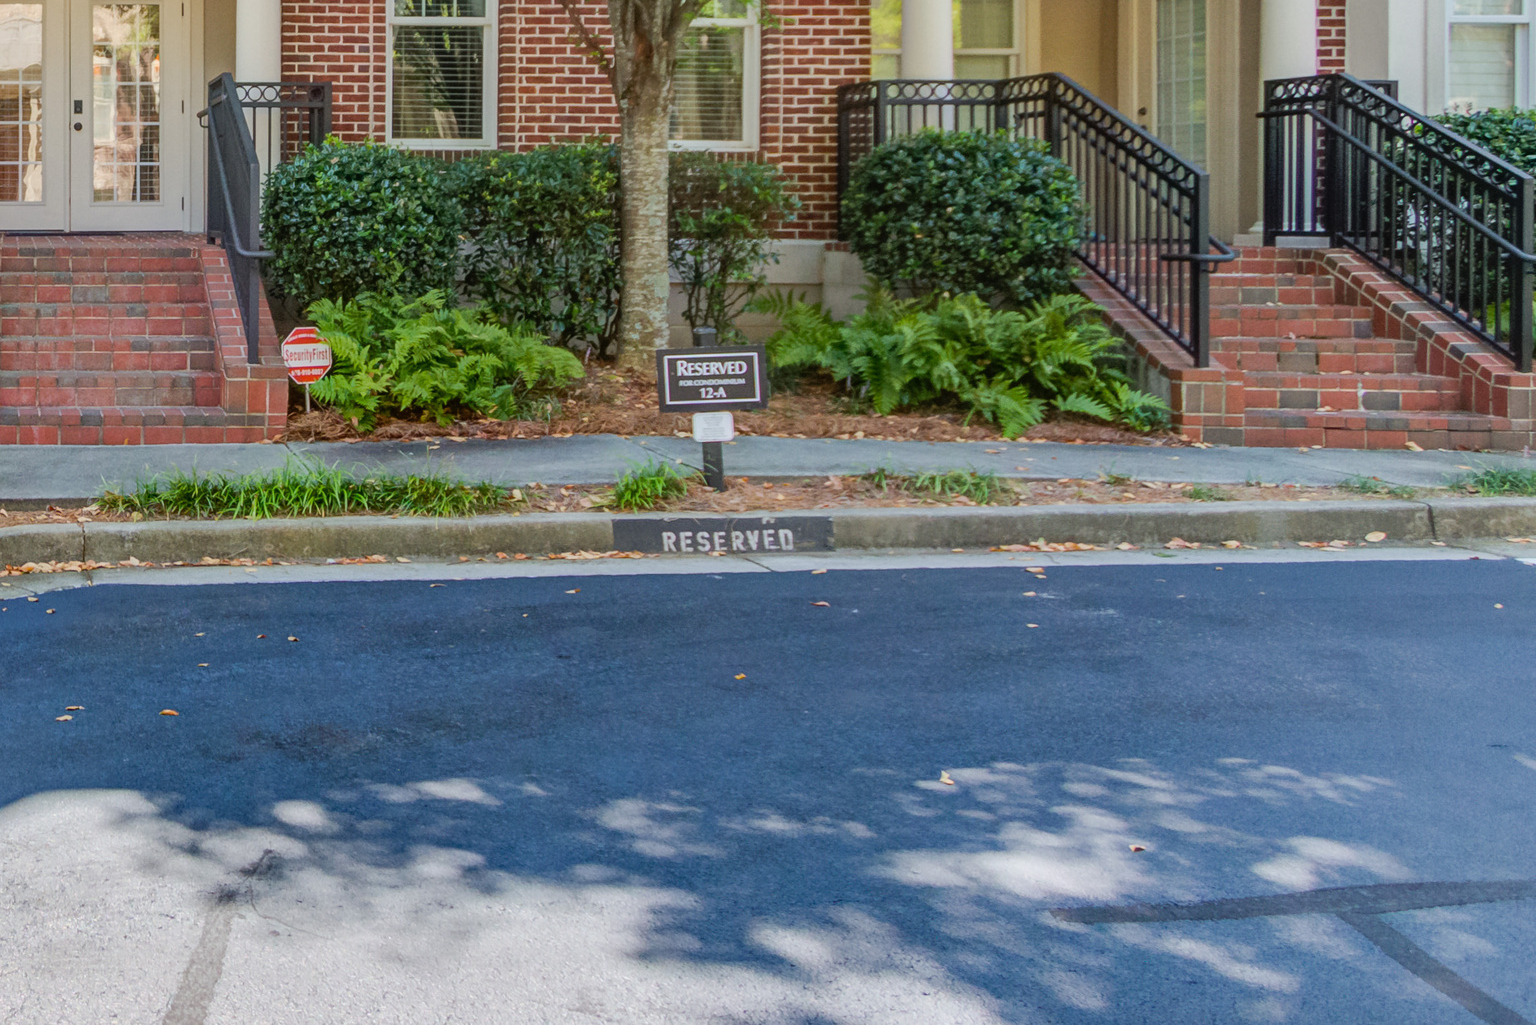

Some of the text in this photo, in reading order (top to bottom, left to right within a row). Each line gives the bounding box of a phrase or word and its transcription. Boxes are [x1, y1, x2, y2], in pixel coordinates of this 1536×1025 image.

[676, 360, 748, 376] RESERVED
[699, 386, 727, 399] 12-A
[661, 529, 795, 552] RESERVED
